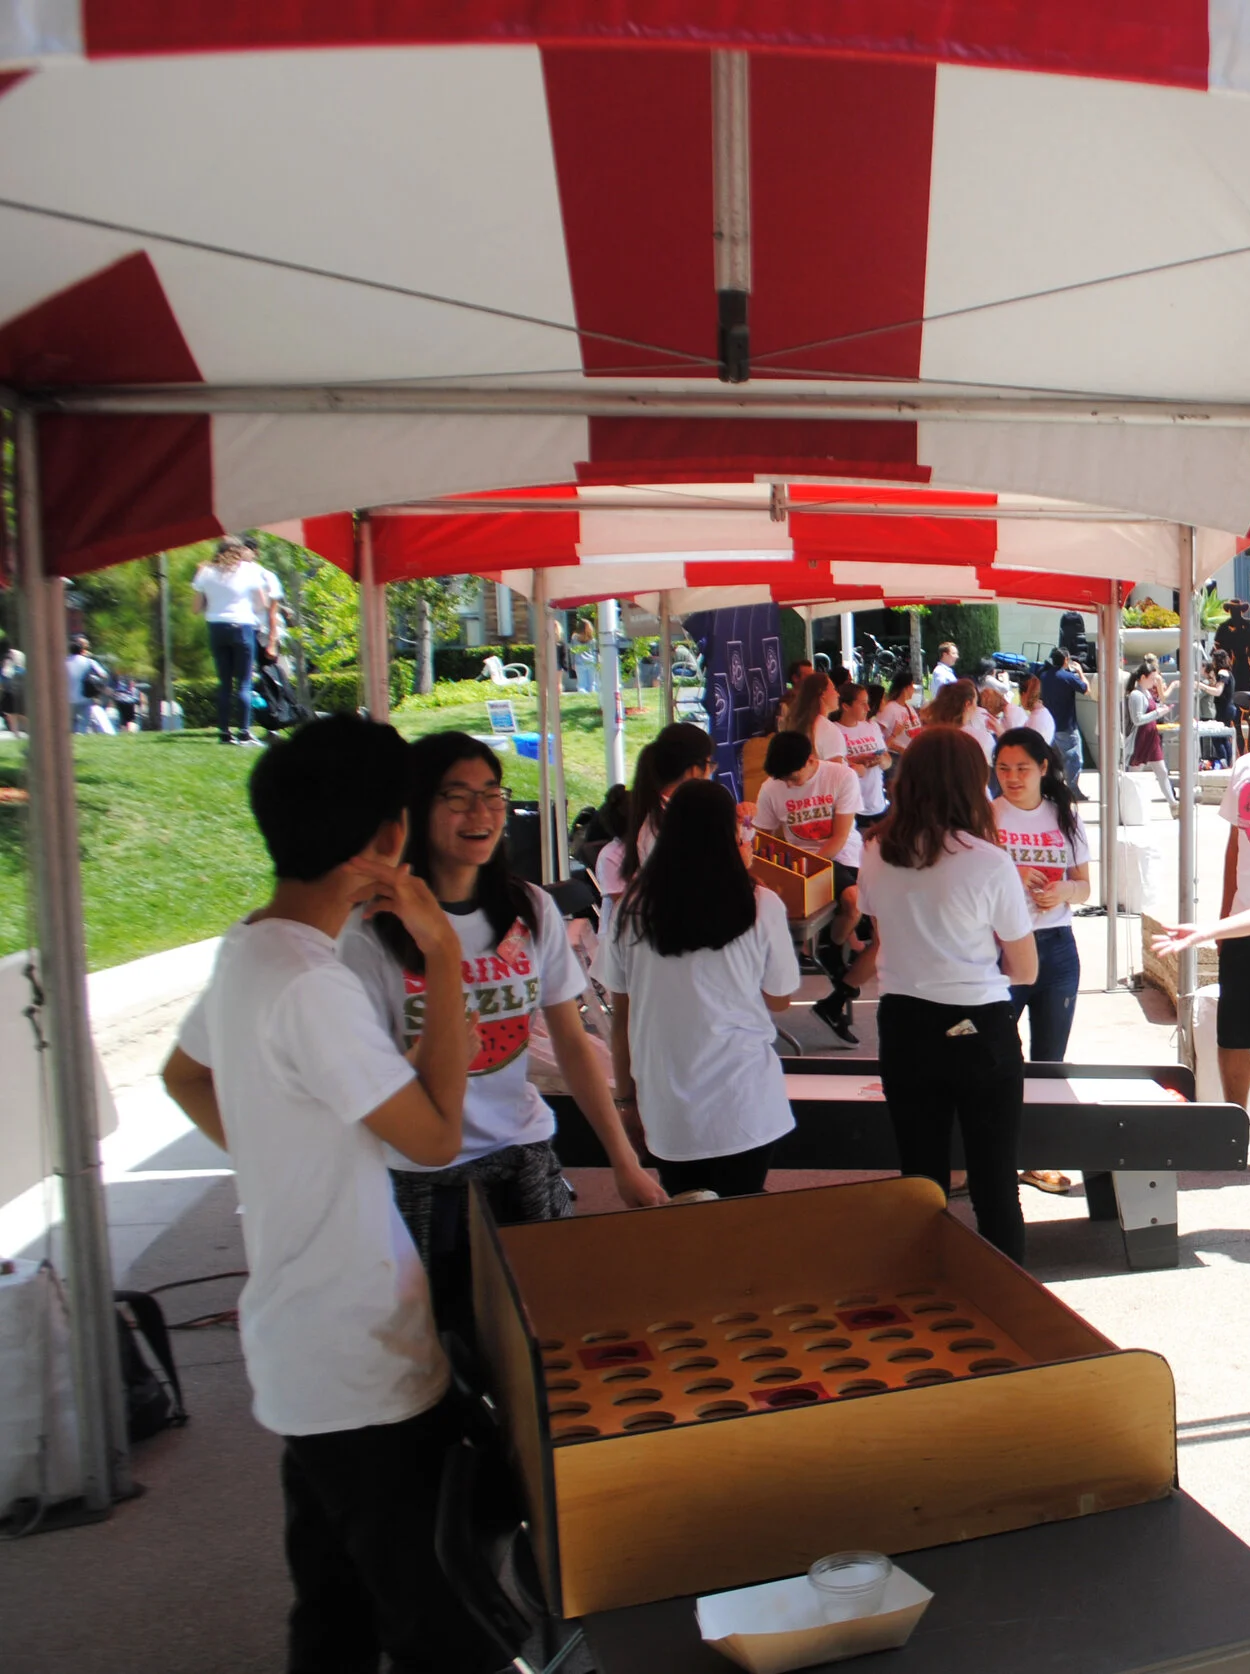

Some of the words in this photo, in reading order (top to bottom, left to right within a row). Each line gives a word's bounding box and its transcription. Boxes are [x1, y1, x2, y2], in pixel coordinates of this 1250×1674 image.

[785, 794, 833, 812] SPRING
[787, 805, 833, 825] SIZZL
[1002, 845, 1067, 864] IZZLE
